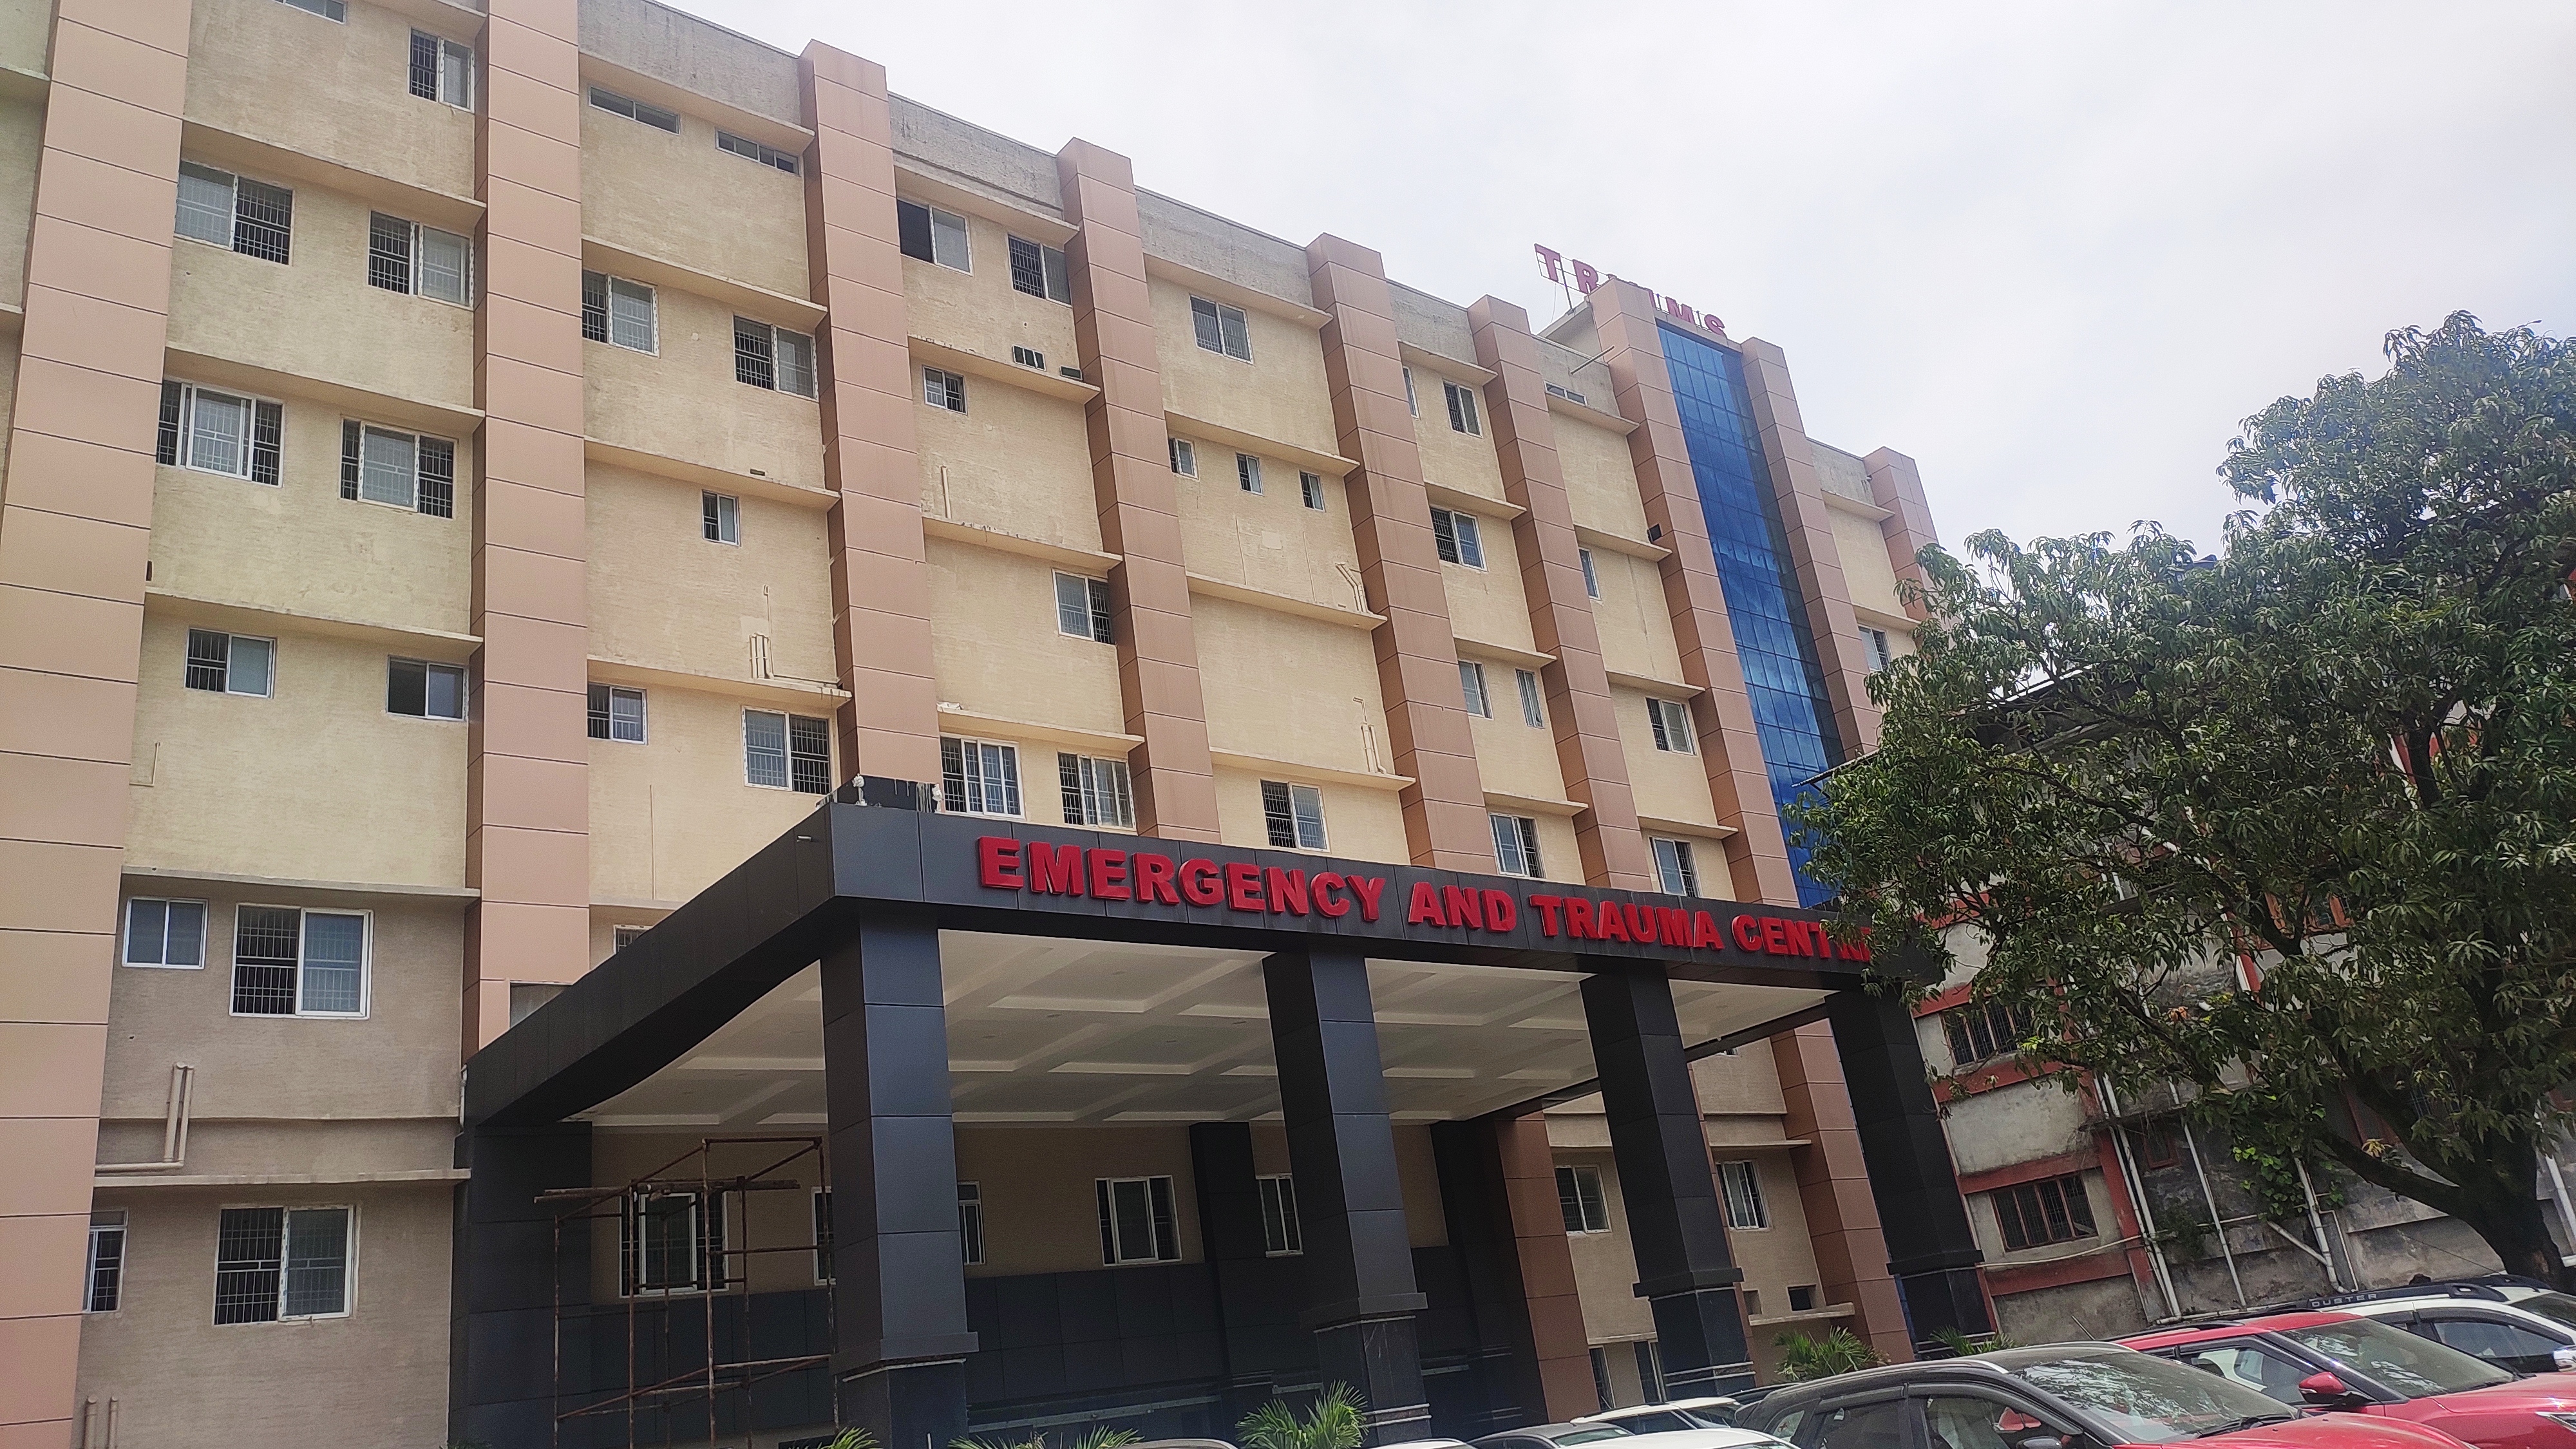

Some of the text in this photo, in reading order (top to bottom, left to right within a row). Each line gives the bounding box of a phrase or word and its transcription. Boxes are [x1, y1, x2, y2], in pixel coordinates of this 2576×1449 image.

[1534, 243, 1727, 336] TRMS
[978, 835, 1386, 922] EMERGENCY
[1408, 881, 1517, 933] AND
[1530, 895, 1725, 951] TRAUMA
[2311, 1293, 2377, 1307] DUSTER
